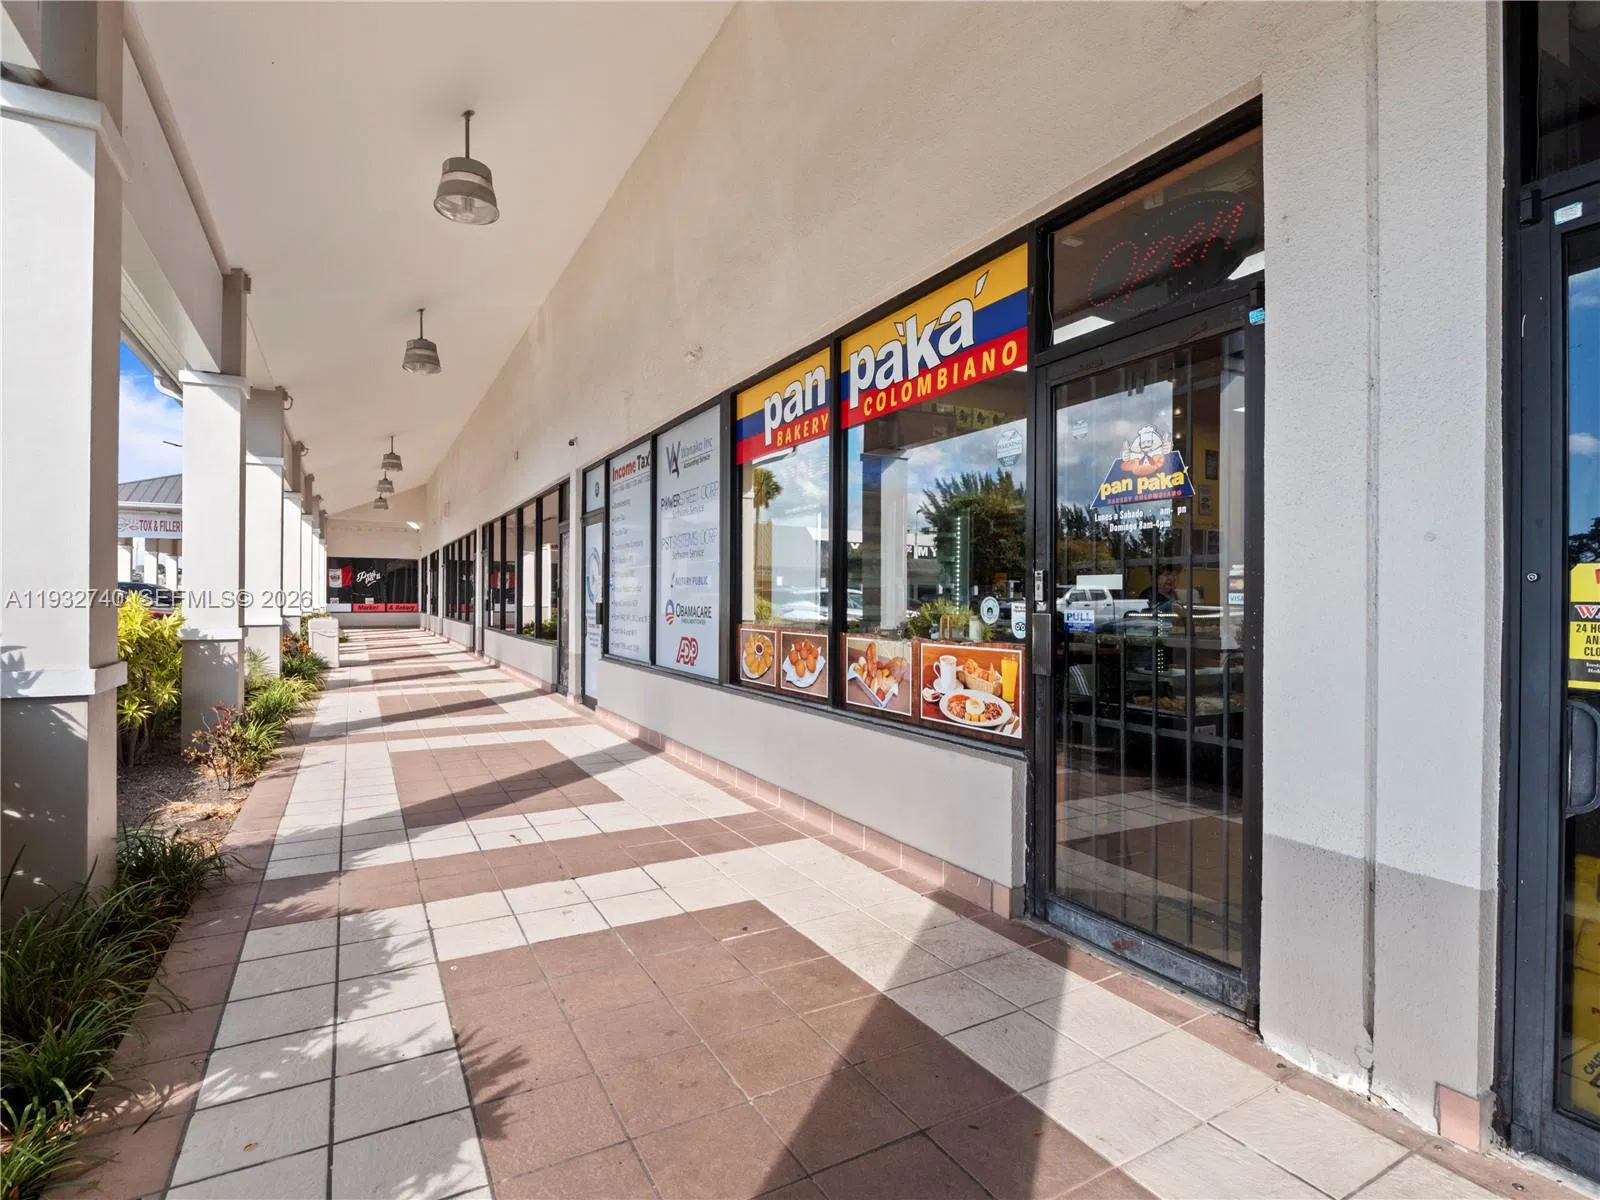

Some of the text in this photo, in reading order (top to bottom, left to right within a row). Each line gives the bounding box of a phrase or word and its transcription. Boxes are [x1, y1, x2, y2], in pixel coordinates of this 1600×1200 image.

[776, 340, 1018, 447] BAKERY COLOMBIANO
[763, 364, 828, 446] pan
[612, 450, 651, 481] Income Tax
[1100, 477, 1133, 500] pan
[1094, 513, 1113, 522] Lunes
[139, 519, 153, 532] TOX
[153, 520, 158, 532] &
[159, 520, 183, 533] FILLER
[1109, 522, 1138, 533] Domingo
[692, 575, 709, 586] PUBLIC
[676, 603, 712, 619] OBAMACARE
[1066, 612, 1093, 622] PULL
[1575, 623, 1587, 633] 24
[676, 636, 699, 666] ADP
